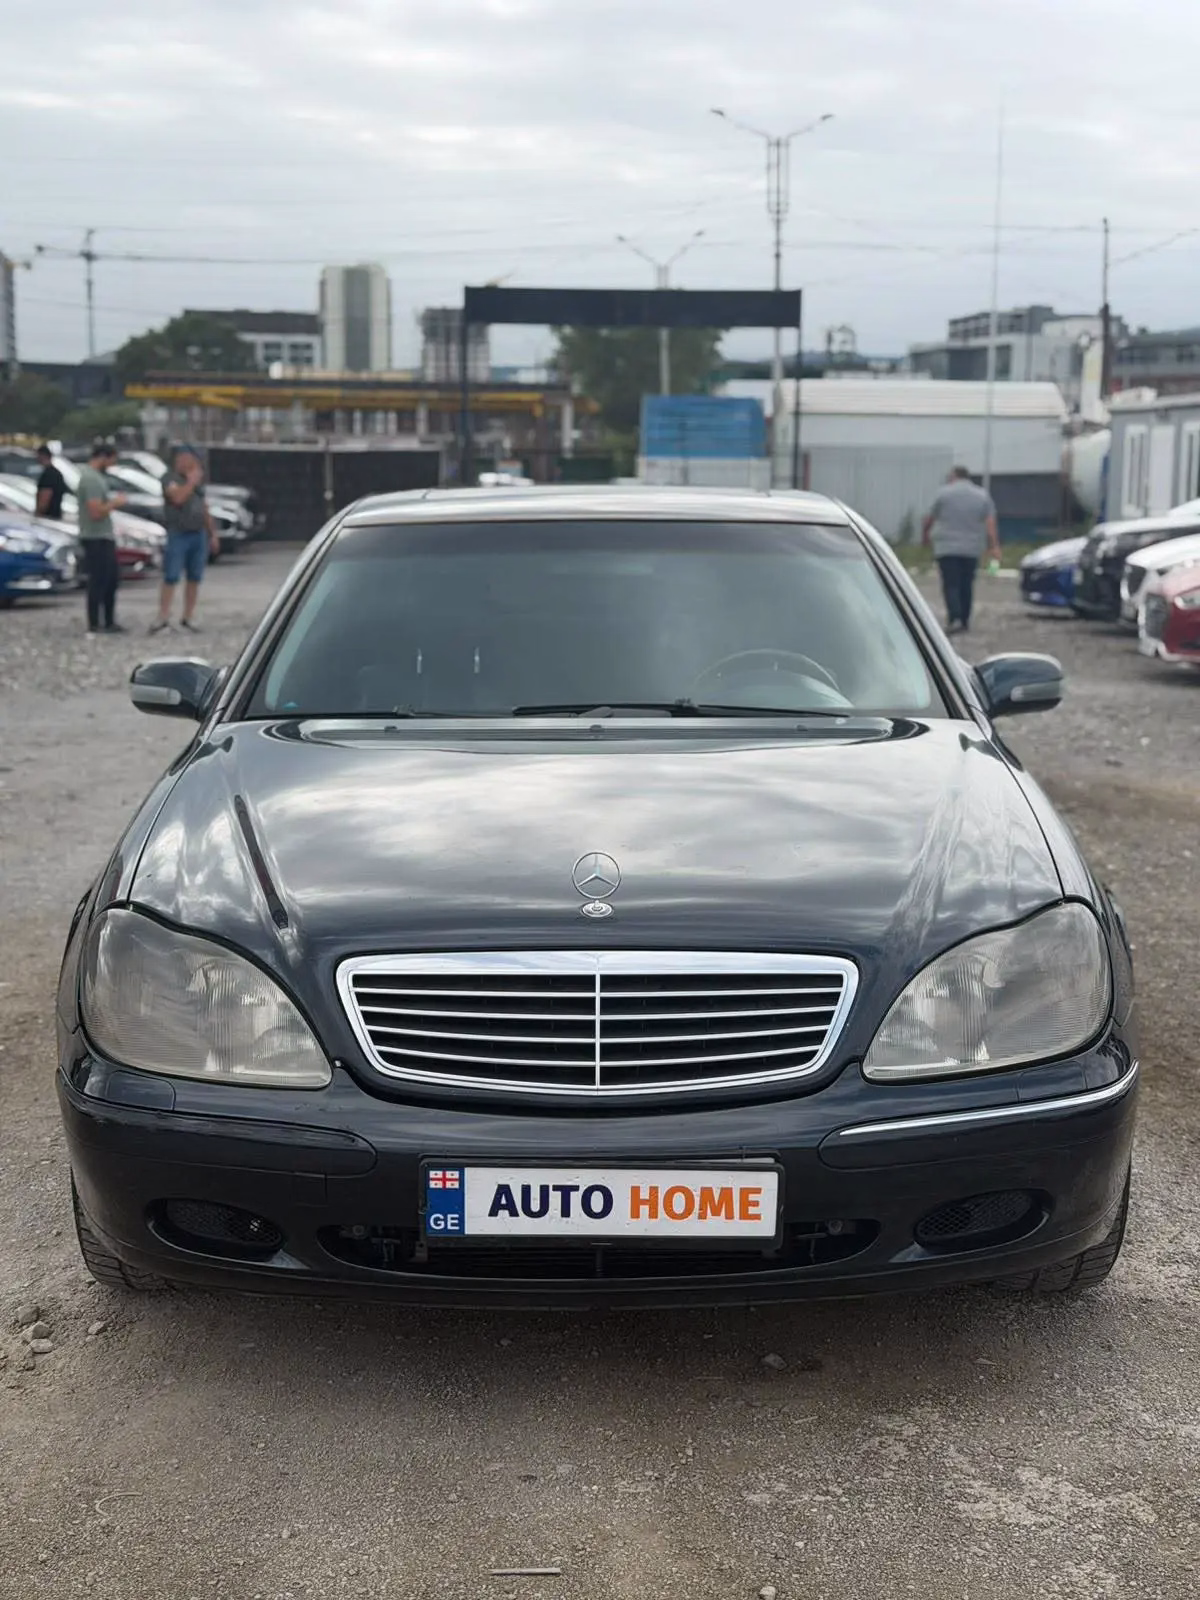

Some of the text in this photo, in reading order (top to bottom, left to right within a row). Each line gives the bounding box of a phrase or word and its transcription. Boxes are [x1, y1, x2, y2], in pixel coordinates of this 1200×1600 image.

[488, 1184, 762, 1221] AUTO HOME
[429, 1213, 460, 1231] GE
